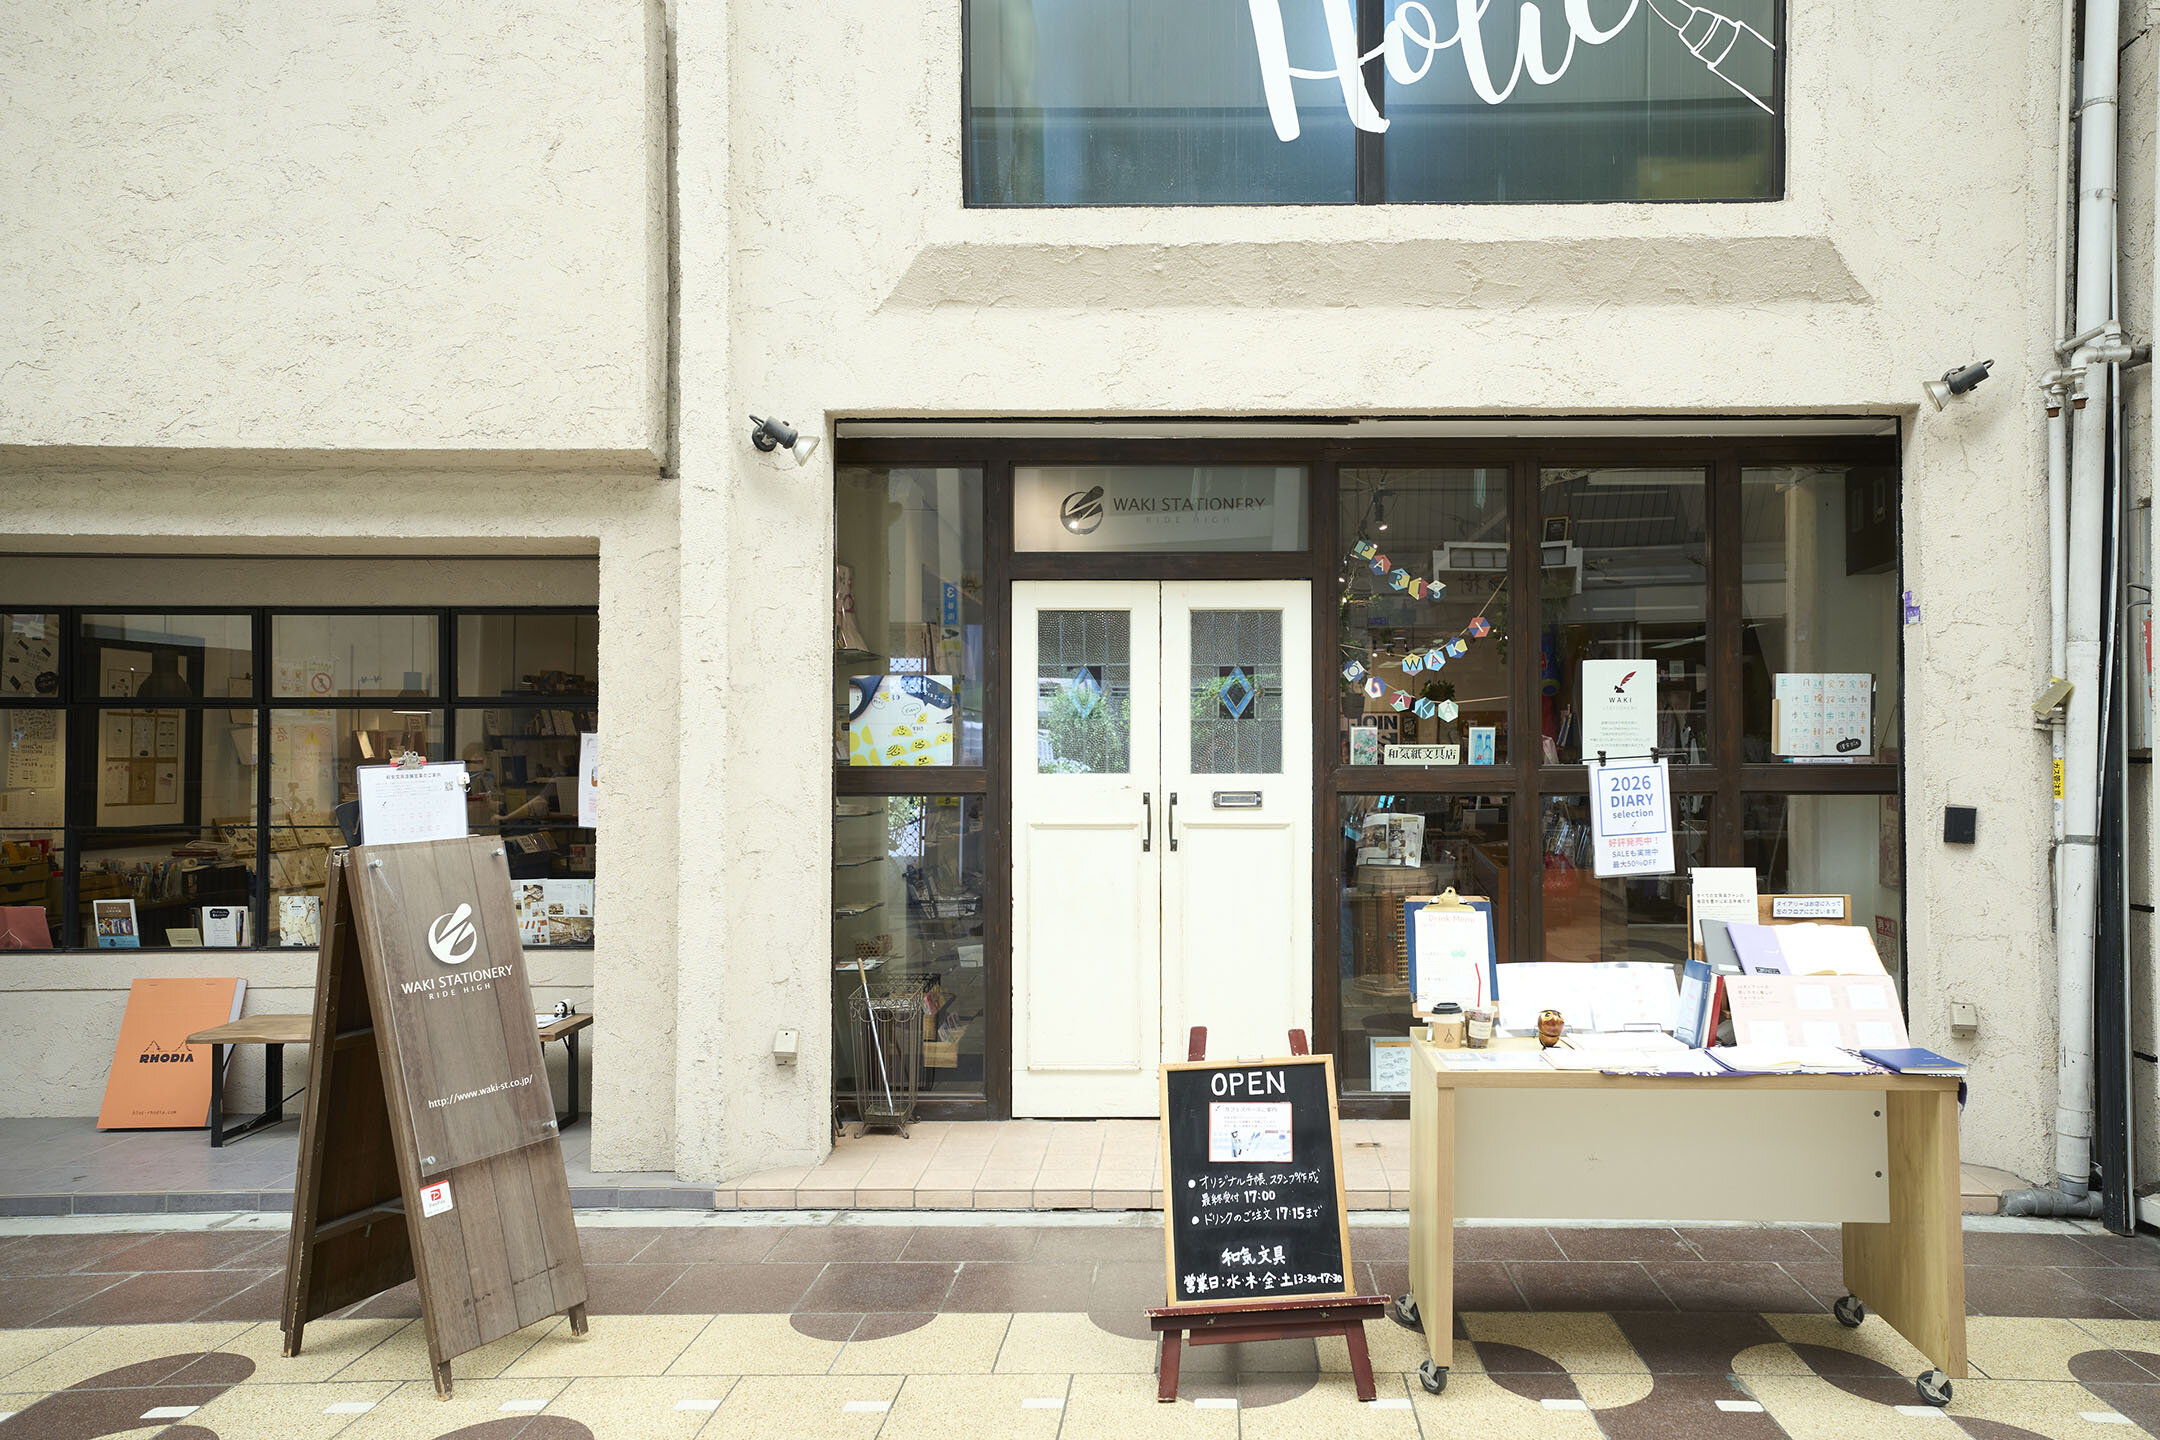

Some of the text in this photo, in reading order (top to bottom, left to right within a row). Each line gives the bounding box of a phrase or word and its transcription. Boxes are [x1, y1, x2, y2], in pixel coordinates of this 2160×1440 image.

[1113, 497, 1266, 511] WAKI STATIONERY
[1146, 516, 1181, 524] RIDE
[1404, 621, 1484, 671] WAKI
[1610, 775, 1652, 792] 2026
[1611, 793, 1653, 808] DIARY
[1612, 809, 1654, 819] selection
[400, 964, 513, 995] WAKI STATIONERY
[428, 982, 492, 1000] RIDE HIGH
[139, 1053, 194, 1064] RHODIA
[427, 1073, 534, 1109] http://www.waki-st.co.jp/
[1210, 1070, 1286, 1097] OPEN
[1243, 1190, 1276, 1204] 17:00
[1221, 1244, 1287, 1267] 和気文具
